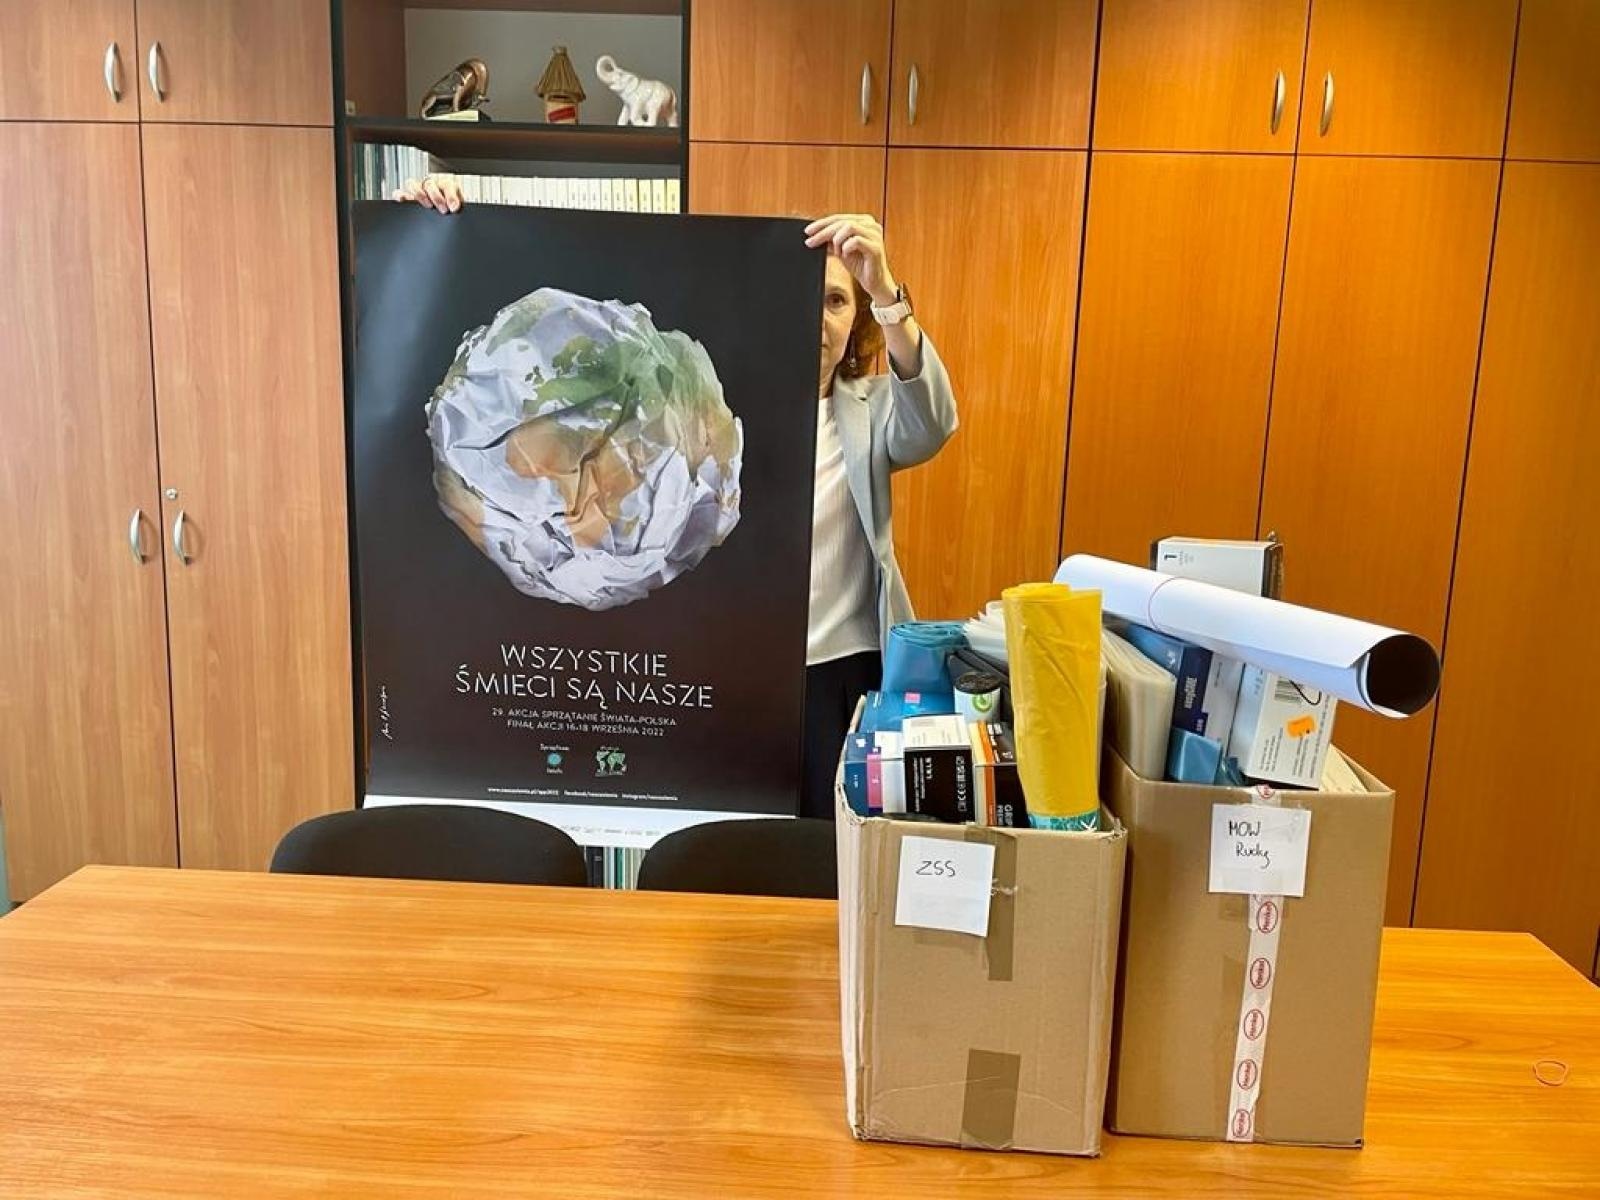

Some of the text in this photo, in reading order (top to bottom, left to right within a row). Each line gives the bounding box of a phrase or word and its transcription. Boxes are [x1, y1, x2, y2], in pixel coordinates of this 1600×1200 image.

[501, 644, 667, 677] WSZYSTKIE
[456, 664, 713, 710] ŚMIECI SĄ NASZE
[508, 708, 540, 718] AKCJA
[541, 710, 598, 722] SPRZĄTANIE
[507, 719, 535, 730] FINAŁ
[537, 721, 564, 731] AKCJI
[591, 723, 640, 735] WRZEŚNIA
[641, 726, 664, 737] 2022
[1229, 820, 1261, 837] MOW
[915, 860, 956, 878] ZSS
